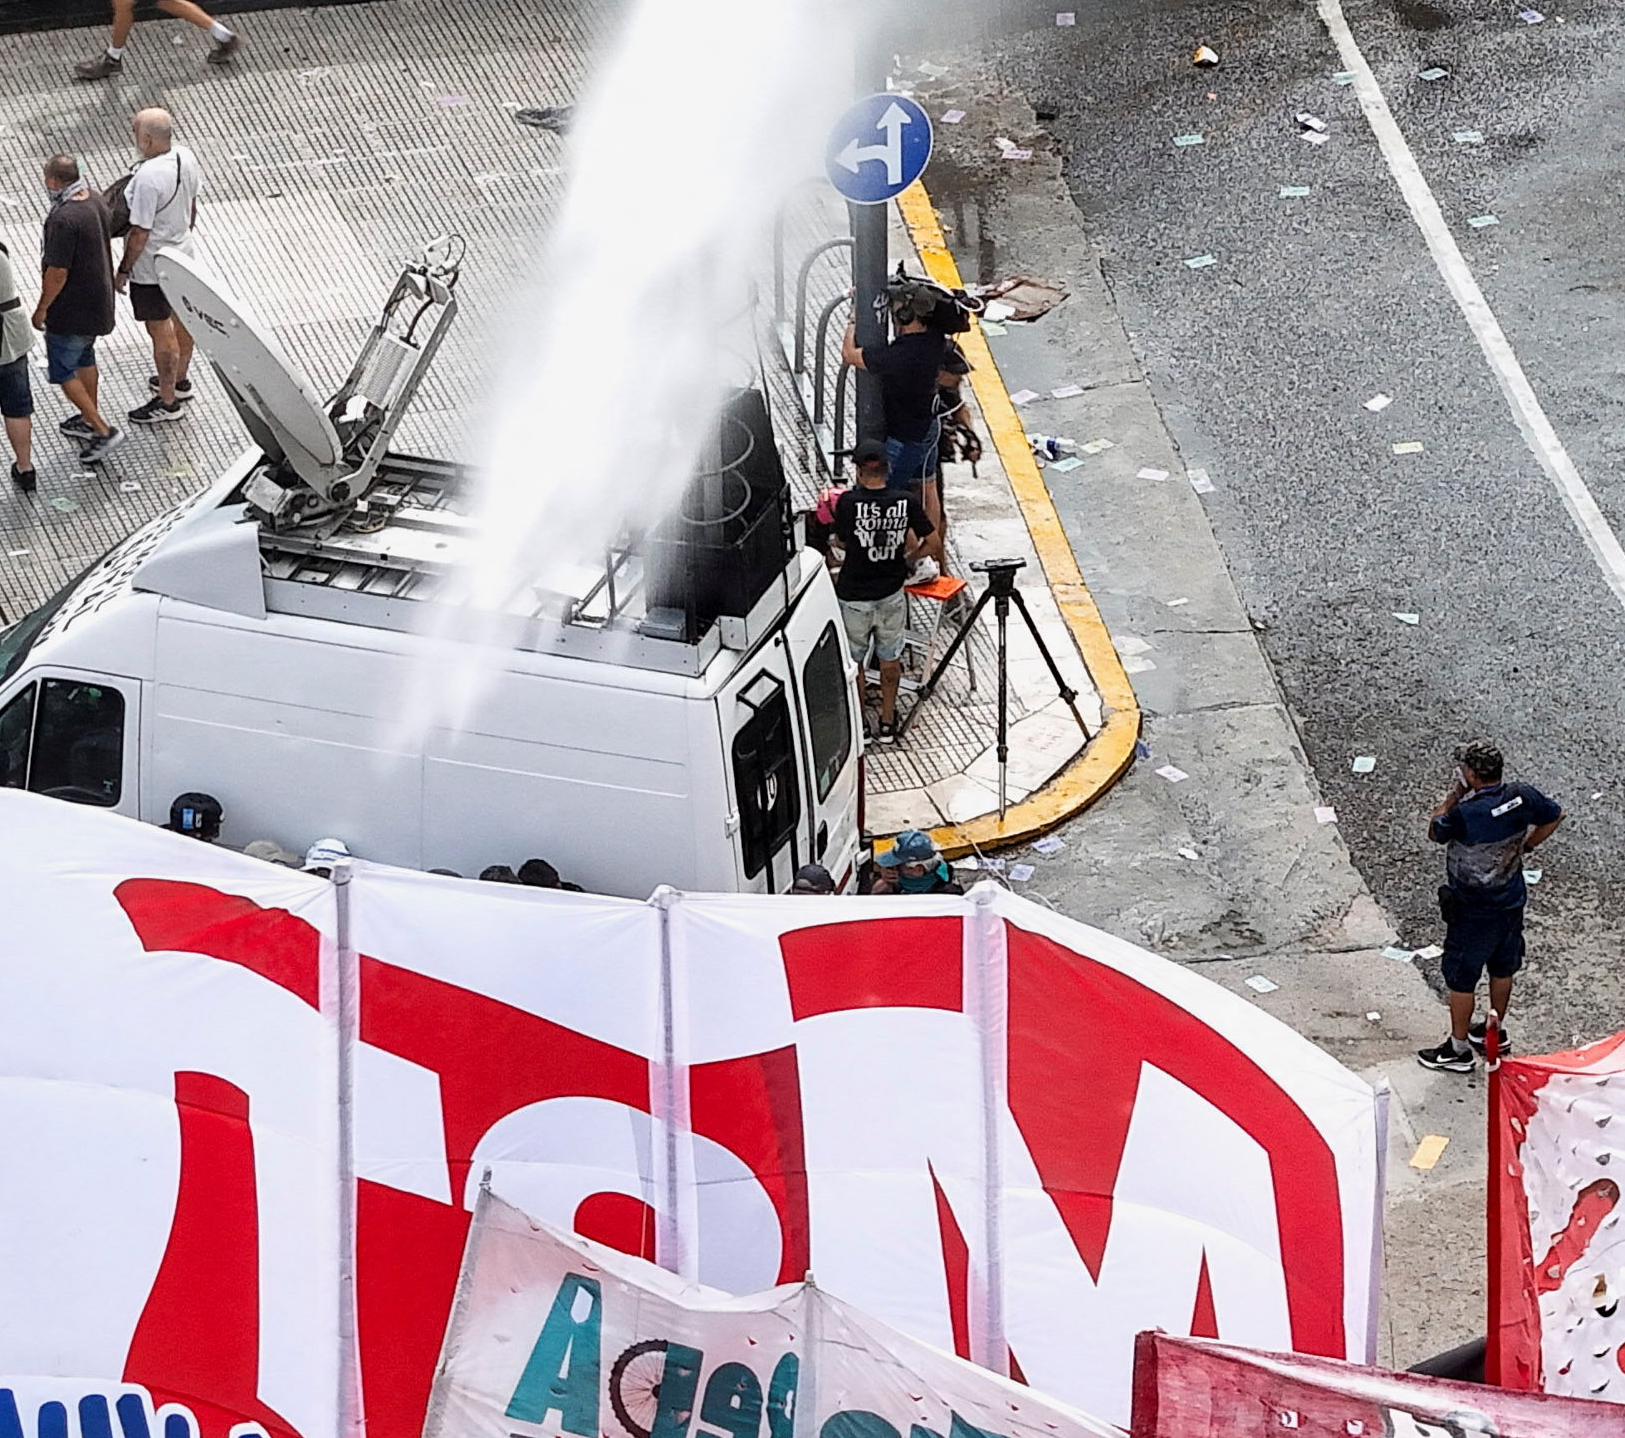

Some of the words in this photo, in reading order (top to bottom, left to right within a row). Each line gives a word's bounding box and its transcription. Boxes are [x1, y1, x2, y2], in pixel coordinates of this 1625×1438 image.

[855, 500, 879, 521] It's
[886, 498, 908, 518] all
[867, 544, 897, 563] OUT
